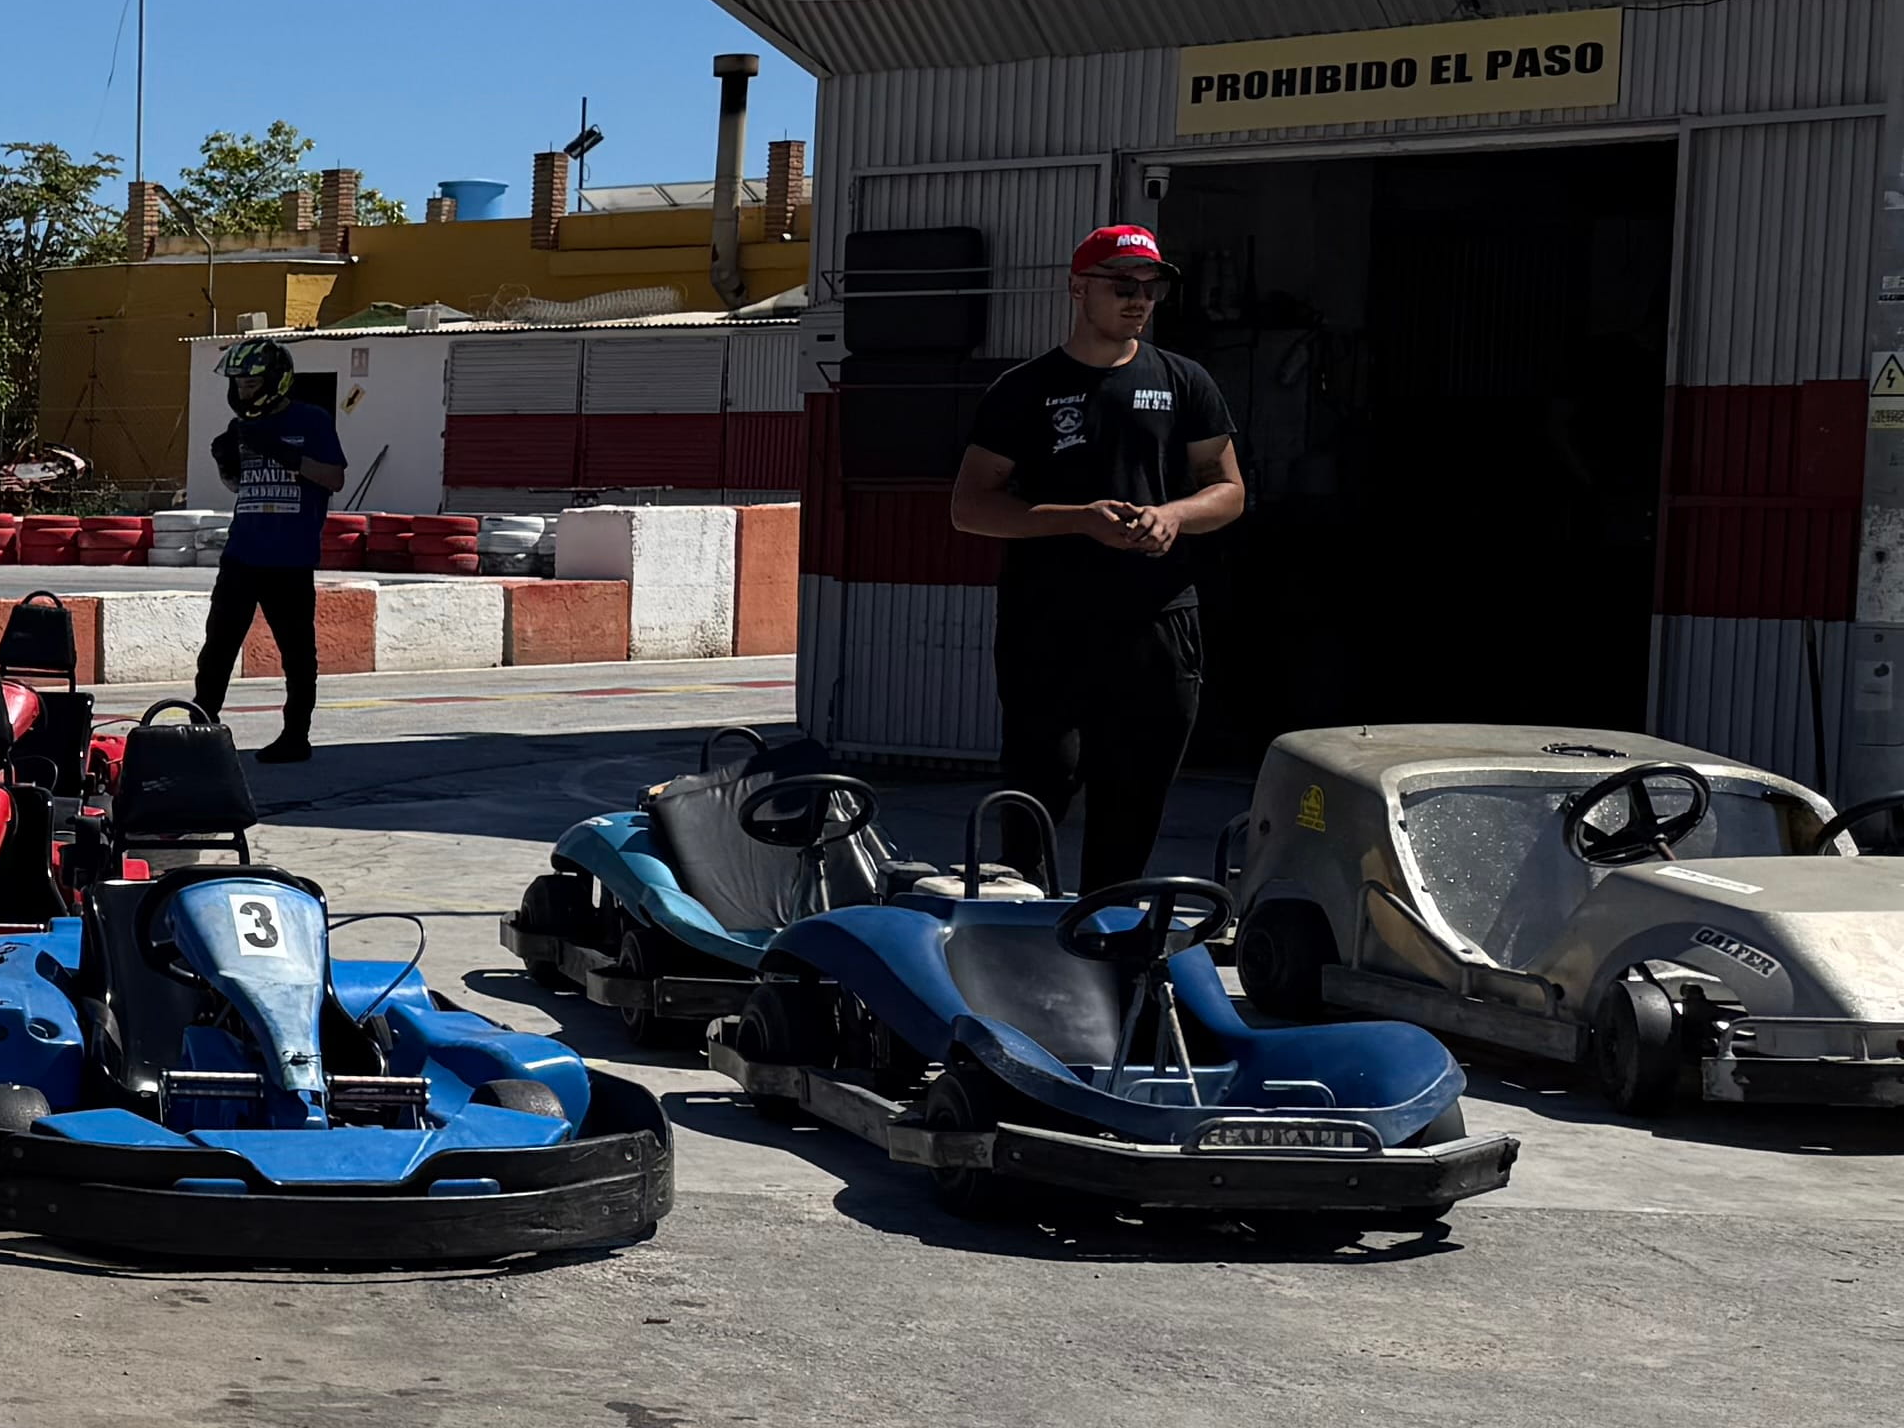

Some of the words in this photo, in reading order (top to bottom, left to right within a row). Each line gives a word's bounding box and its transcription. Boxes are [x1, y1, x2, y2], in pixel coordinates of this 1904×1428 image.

[1191, 57, 1418, 105] PROHIBIDO
[1430, 53, 1473, 86] EL
[1486, 41, 1605, 81] PASO
[239, 901, 279, 949] 3
[1695, 928, 1776, 977] GALFER
